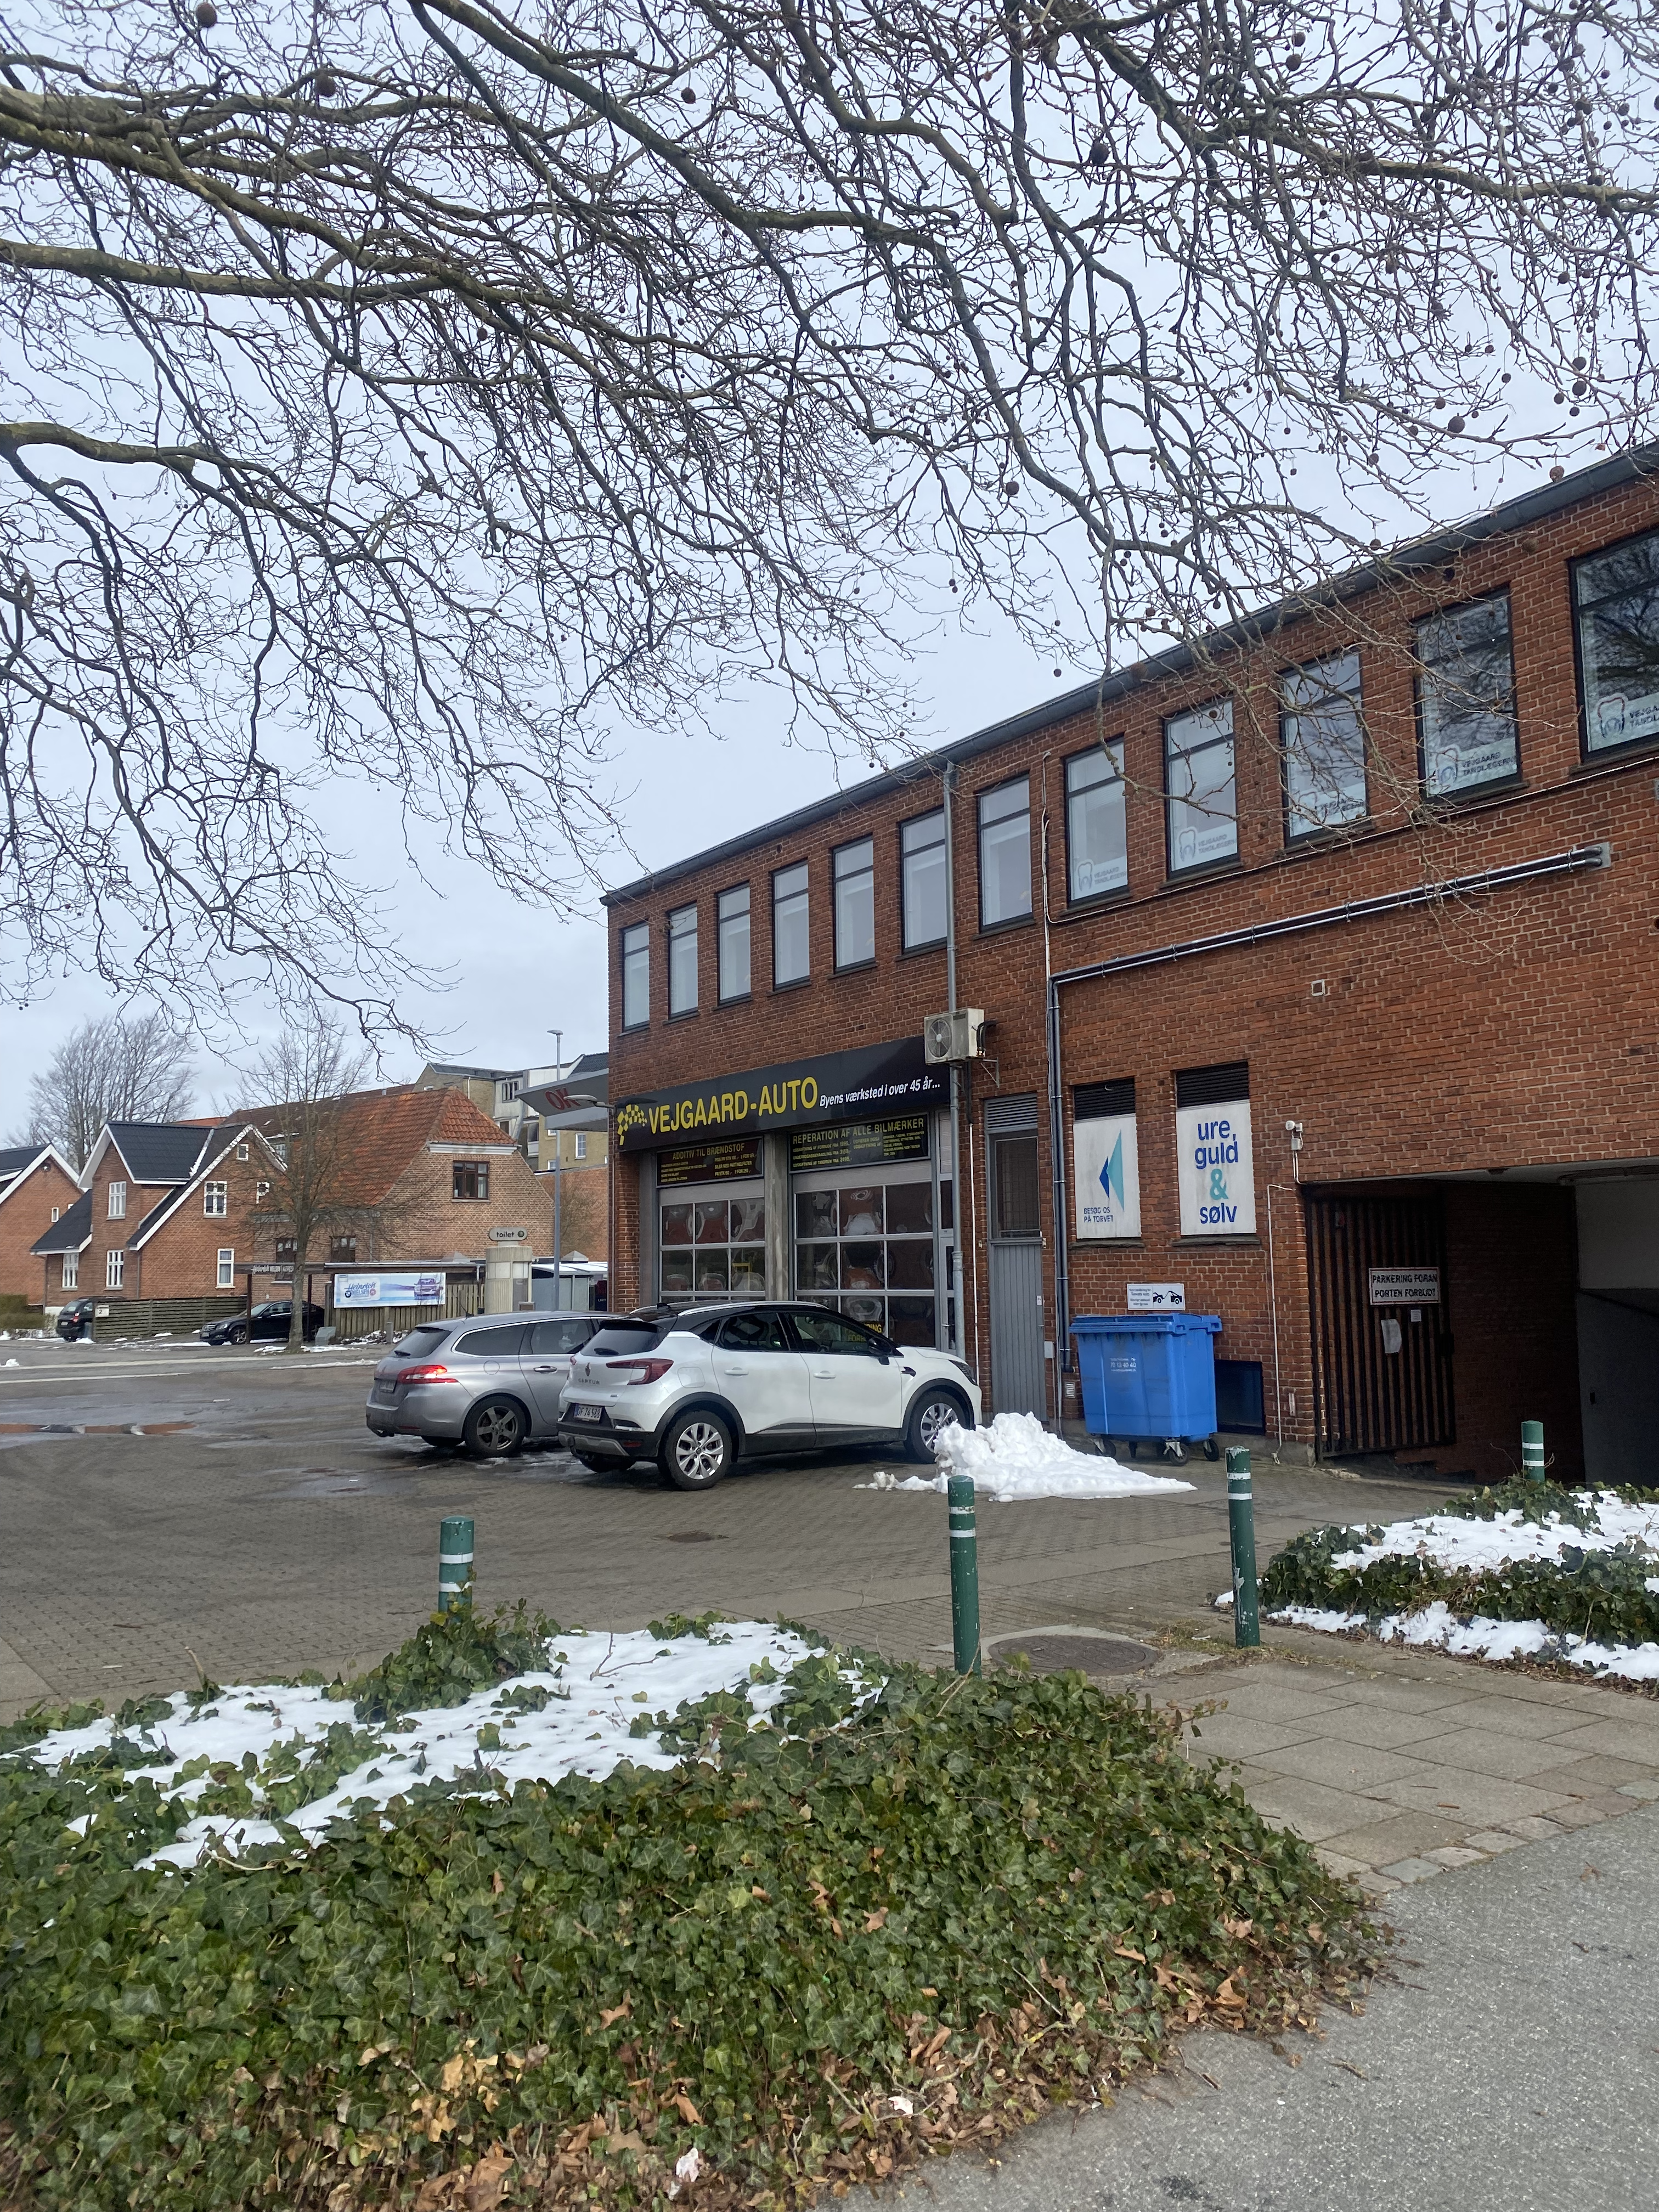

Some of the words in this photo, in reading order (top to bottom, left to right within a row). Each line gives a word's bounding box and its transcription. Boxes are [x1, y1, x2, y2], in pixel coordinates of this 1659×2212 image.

[545, 1087, 581, 1110] OK
[648, 1077, 818, 1134] VEJGAARD-AUTO
[820, 1093, 844, 1109] Byens
[845, 1085, 884, 1103] værksted
[884, 1084, 888, 1096] i
[889, 1082, 908, 1096] over
[910, 1079, 921, 1092] 45
[923, 1076, 940, 1090] år...
[793, 1130, 839, 1144] REPERATION
[841, 1128, 850, 1138] AF
[853, 1125, 872, 1137] ALLE
[874, 1118, 924, 1133] BILMÆRKER
[1198, 1120, 1236, 1141] ure,
[673, 1152, 695, 1160] ADDITIV
[707, 1143, 745, 1156] BRÆNDSTOF
[1194, 1141, 1238, 1170] guld
[1210, 1169, 1229, 1200] &
[1084, 1215, 1091, 1223] PÅ
[1200, 1203, 1237, 1224] sølv
[1372, 1274, 1413, 1283] PARKERING
[1414, 1274, 1437, 1283] FORAN
[1375, 1289, 1403, 1298] PORTEN
[1404, 1288, 1436, 1297] FORBUDT
